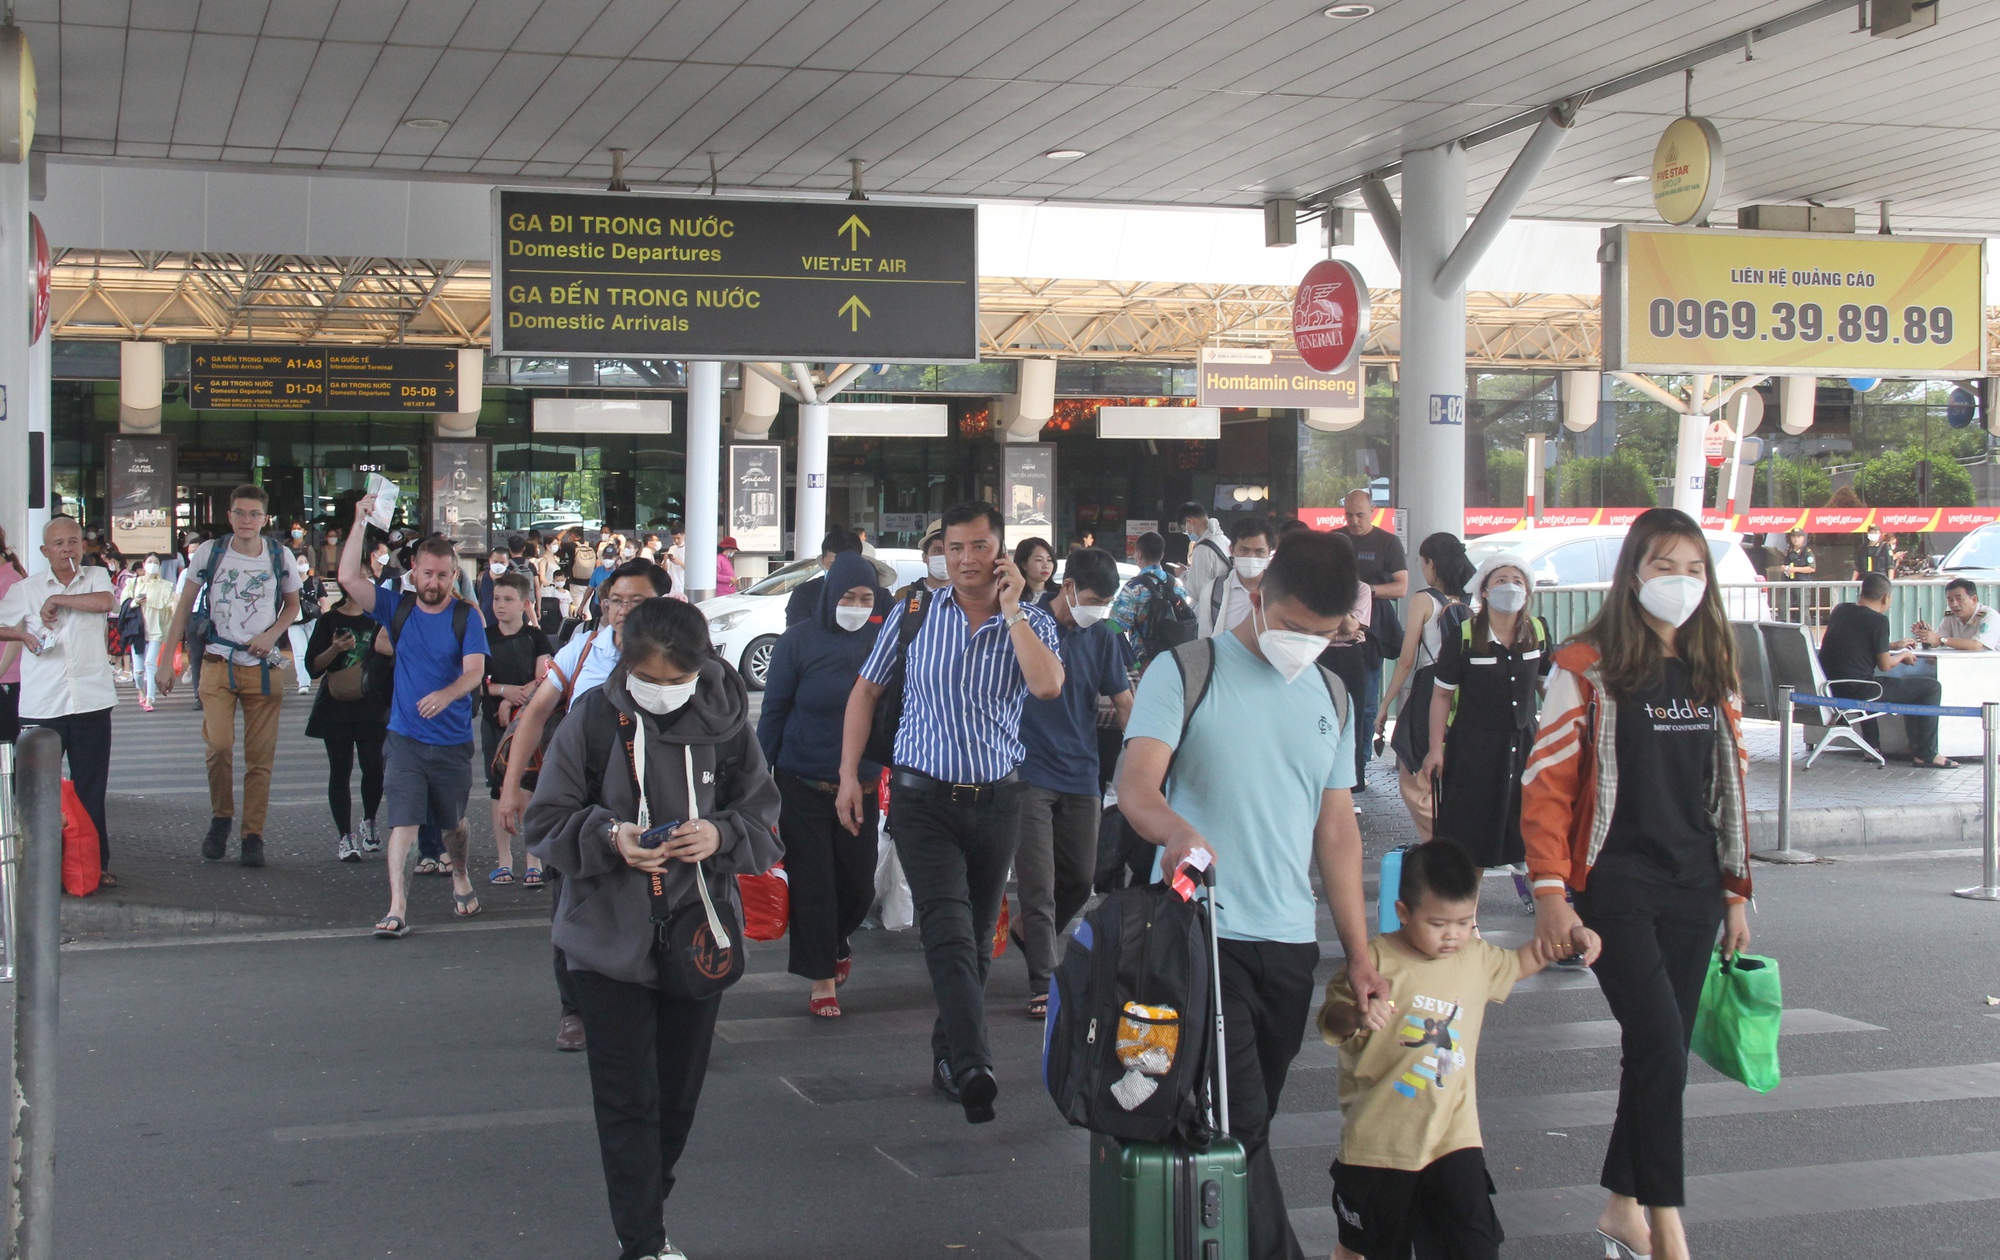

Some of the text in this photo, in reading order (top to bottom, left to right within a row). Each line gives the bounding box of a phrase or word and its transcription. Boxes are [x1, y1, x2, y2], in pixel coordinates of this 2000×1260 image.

[1669, 165, 1689, 178] STAR
[509, 213, 735, 238] GA ĐI TRONG NƯỚC
[509, 239, 722, 265] Domestic Departures
[801, 256, 908, 274] VIETJET AIR
[1731, 266, 1875, 288] LIÊN HỆ QUẢNG CÁO
[509, 279, 761, 309] GA ĐẾN TRONG NƯỚC
[509, 311, 689, 332] Domestic Arrivals
[1649, 297, 1954, 346] 0969.39.89.89
[1297, 331, 1344, 350] GENERALI
[286, 359, 322, 369] A1-A3
[286, 384, 322, 394] D1-D4
[401, 386, 437, 397] D5-D8
[1207, 372, 1356, 395] Homtamin Ginseng
[1430, 397, 1462, 423] B-02
[1644, 698, 1712, 719] toddle.
